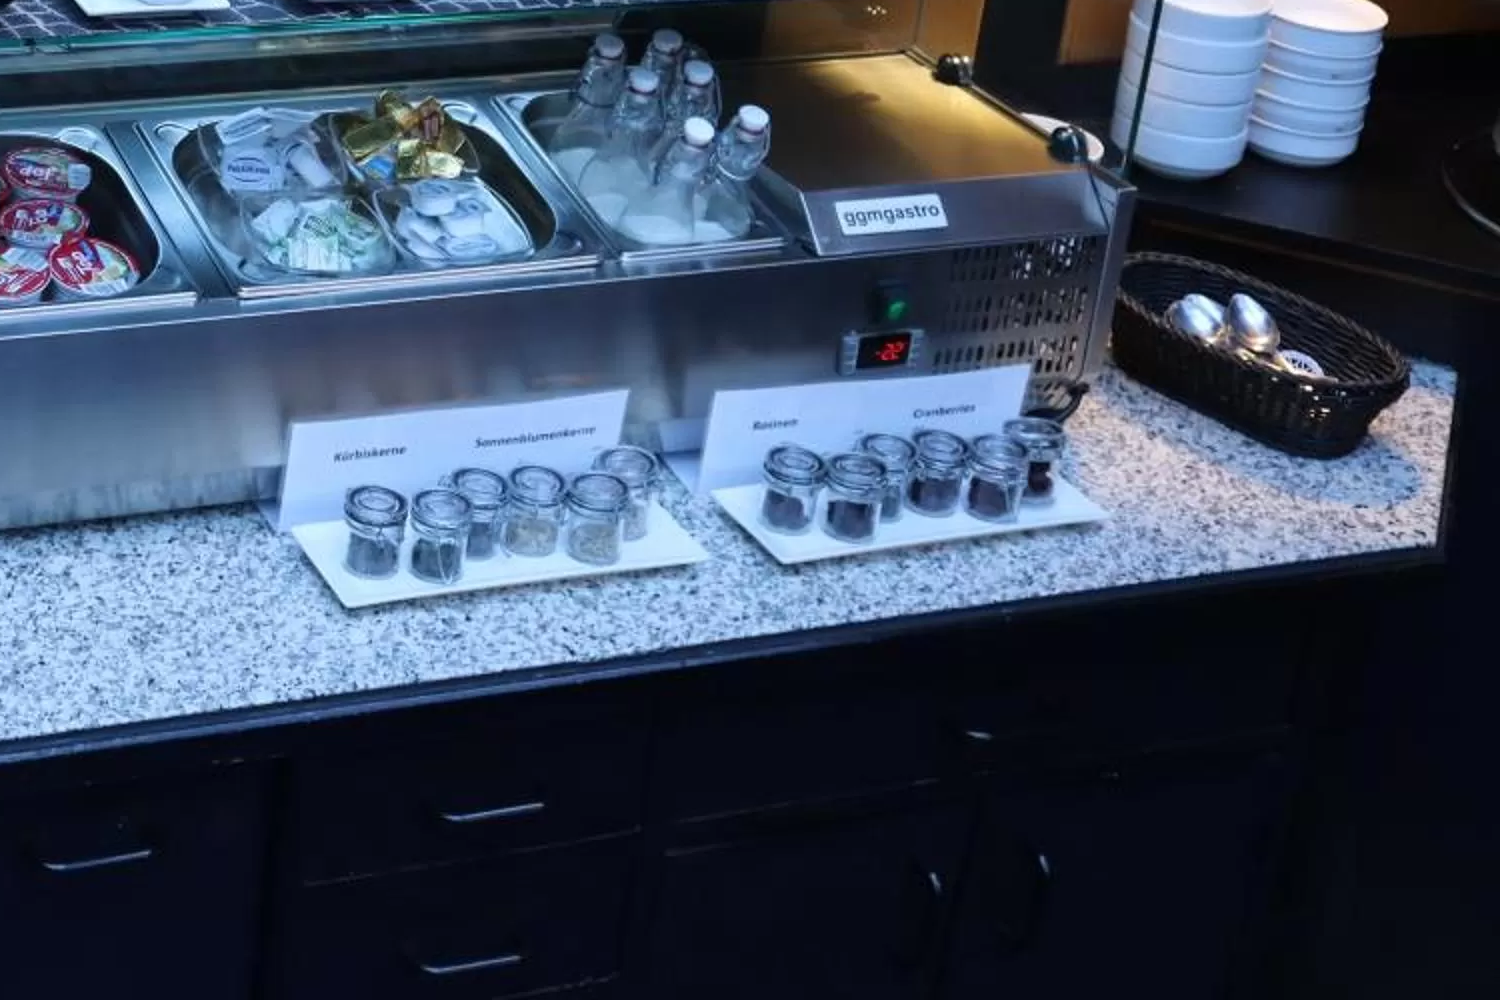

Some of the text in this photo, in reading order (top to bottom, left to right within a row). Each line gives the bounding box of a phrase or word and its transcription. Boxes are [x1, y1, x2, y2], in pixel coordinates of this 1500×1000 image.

[842, 203, 941, 227] ggmgastro
[912, 404, 977, 419] Cranberries
[474, 426, 596, 449] Sonnenblumenkerne
[333, 445, 408, 464] Kürbiskerne
